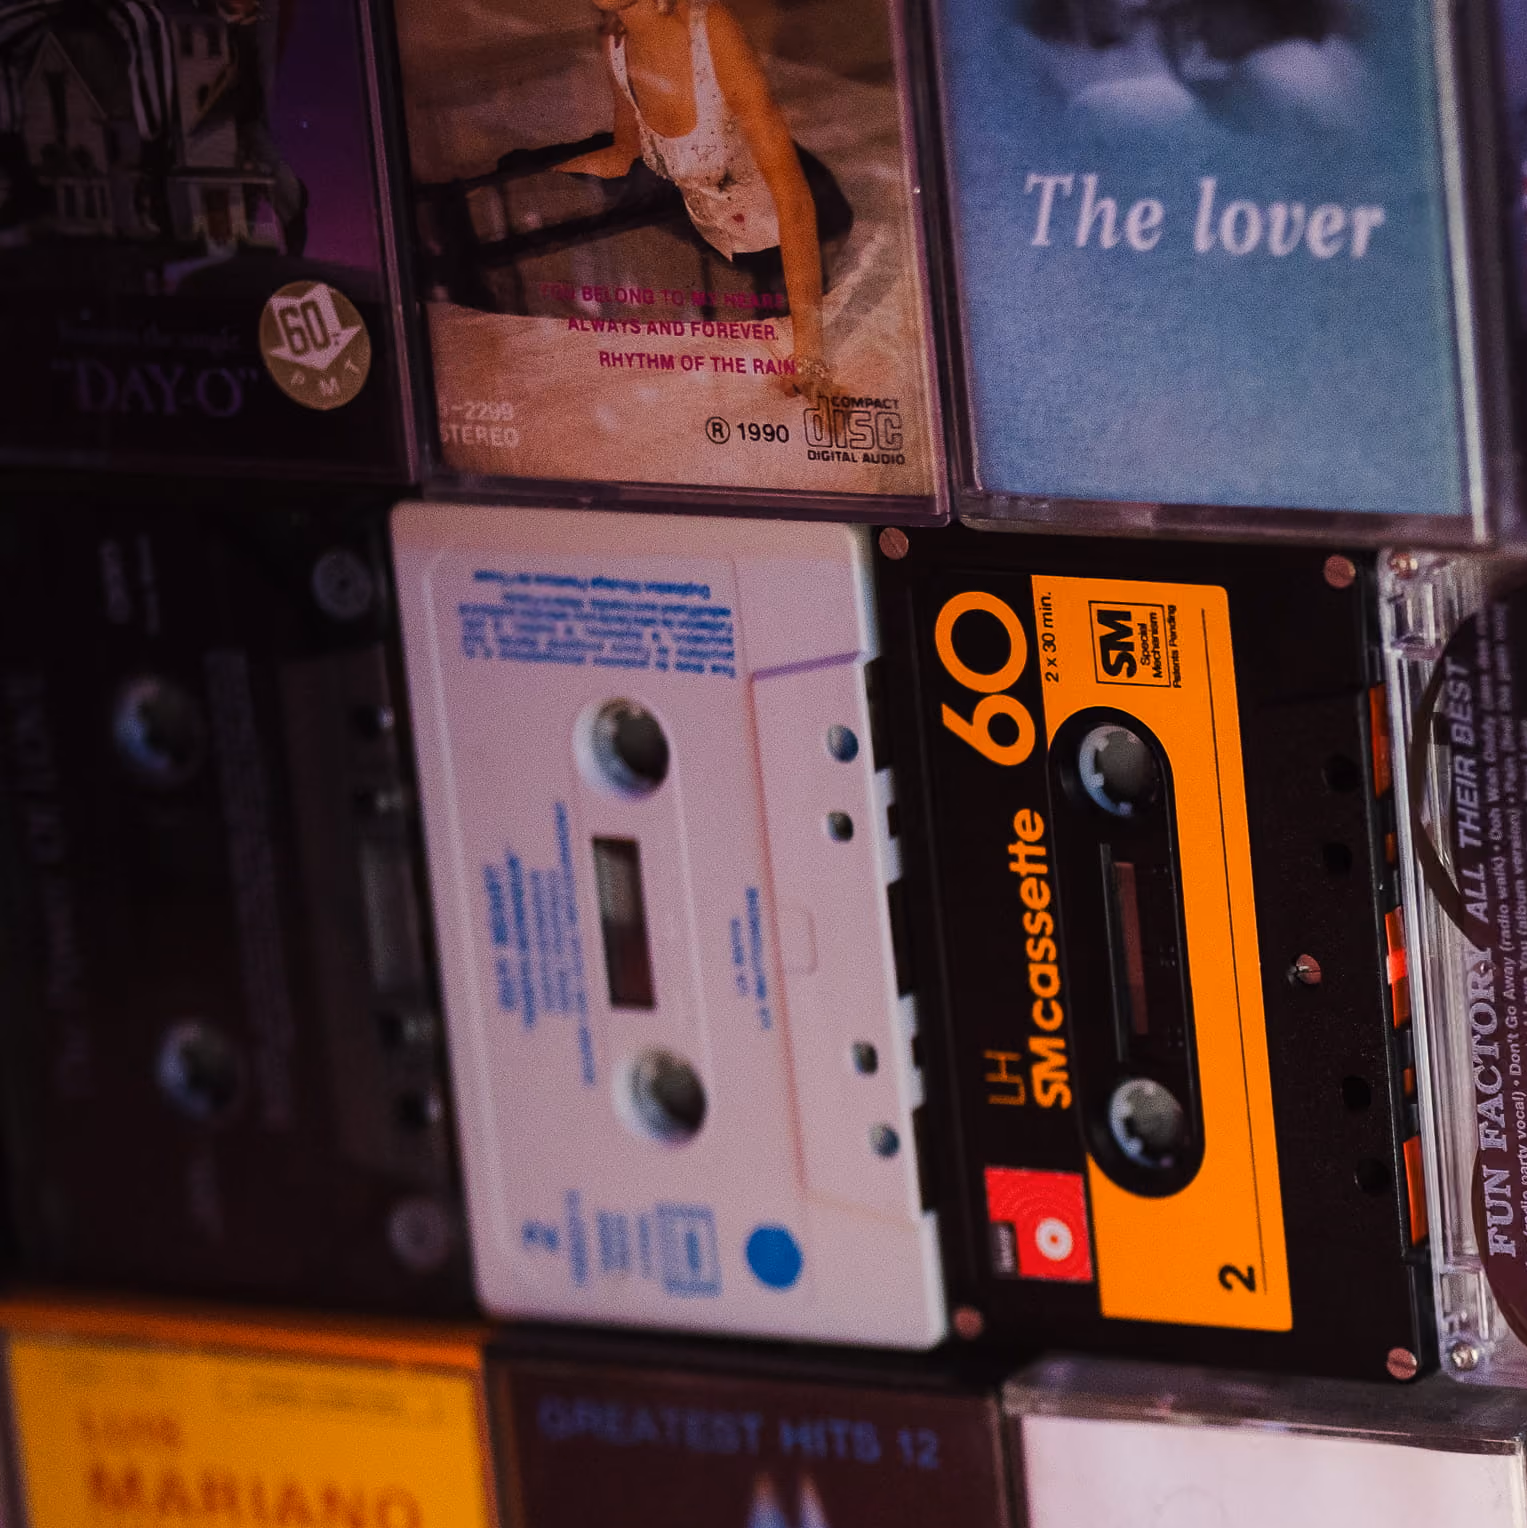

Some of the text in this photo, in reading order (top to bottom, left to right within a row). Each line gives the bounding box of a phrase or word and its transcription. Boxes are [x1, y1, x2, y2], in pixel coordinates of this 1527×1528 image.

[1025, 172, 1386, 259] The lover
[582, 286, 656, 307] BELONG
[662, 289, 686, 308] TO
[280, 300, 331, 356] 60
[567, 316, 642, 335] ALWAYS
[646, 320, 686, 338] AND
[599, 351, 798, 378] RHYTHM OF THE RAIN
[830, 397, 901, 411] COMPACT
[737, 422, 789, 444] 1990
[806, 449, 906, 467] DIGITAL AUDIO
[1040, 592, 1059, 683] 2 x 30 min.
[1096, 610, 1137, 679] SM
[1137, 623, 1151, 666] Special
[1150, 612, 1163, 679] Mechanism
[1167, 605, 1181, 689] Patents Pending
[934, 591, 1036, 767] 60
[1497, 903, 1516, 952] (radio
[1444, 655, 1517, 1258] FUN FACTORY ALL THEIR BEST
[1500, 957, 1517, 1001] Away
[1504, 1005, 1519, 1030] Go
[984, 1050, 1025, 1106] LH
[1506, 1033, 1522, 1077] Don't
[1511, 1091, 1527, 1140] vocal)
[1219, 1263, 1256, 1293] 2
[536, 1396, 942, 1473] GREATEST HITS 12
